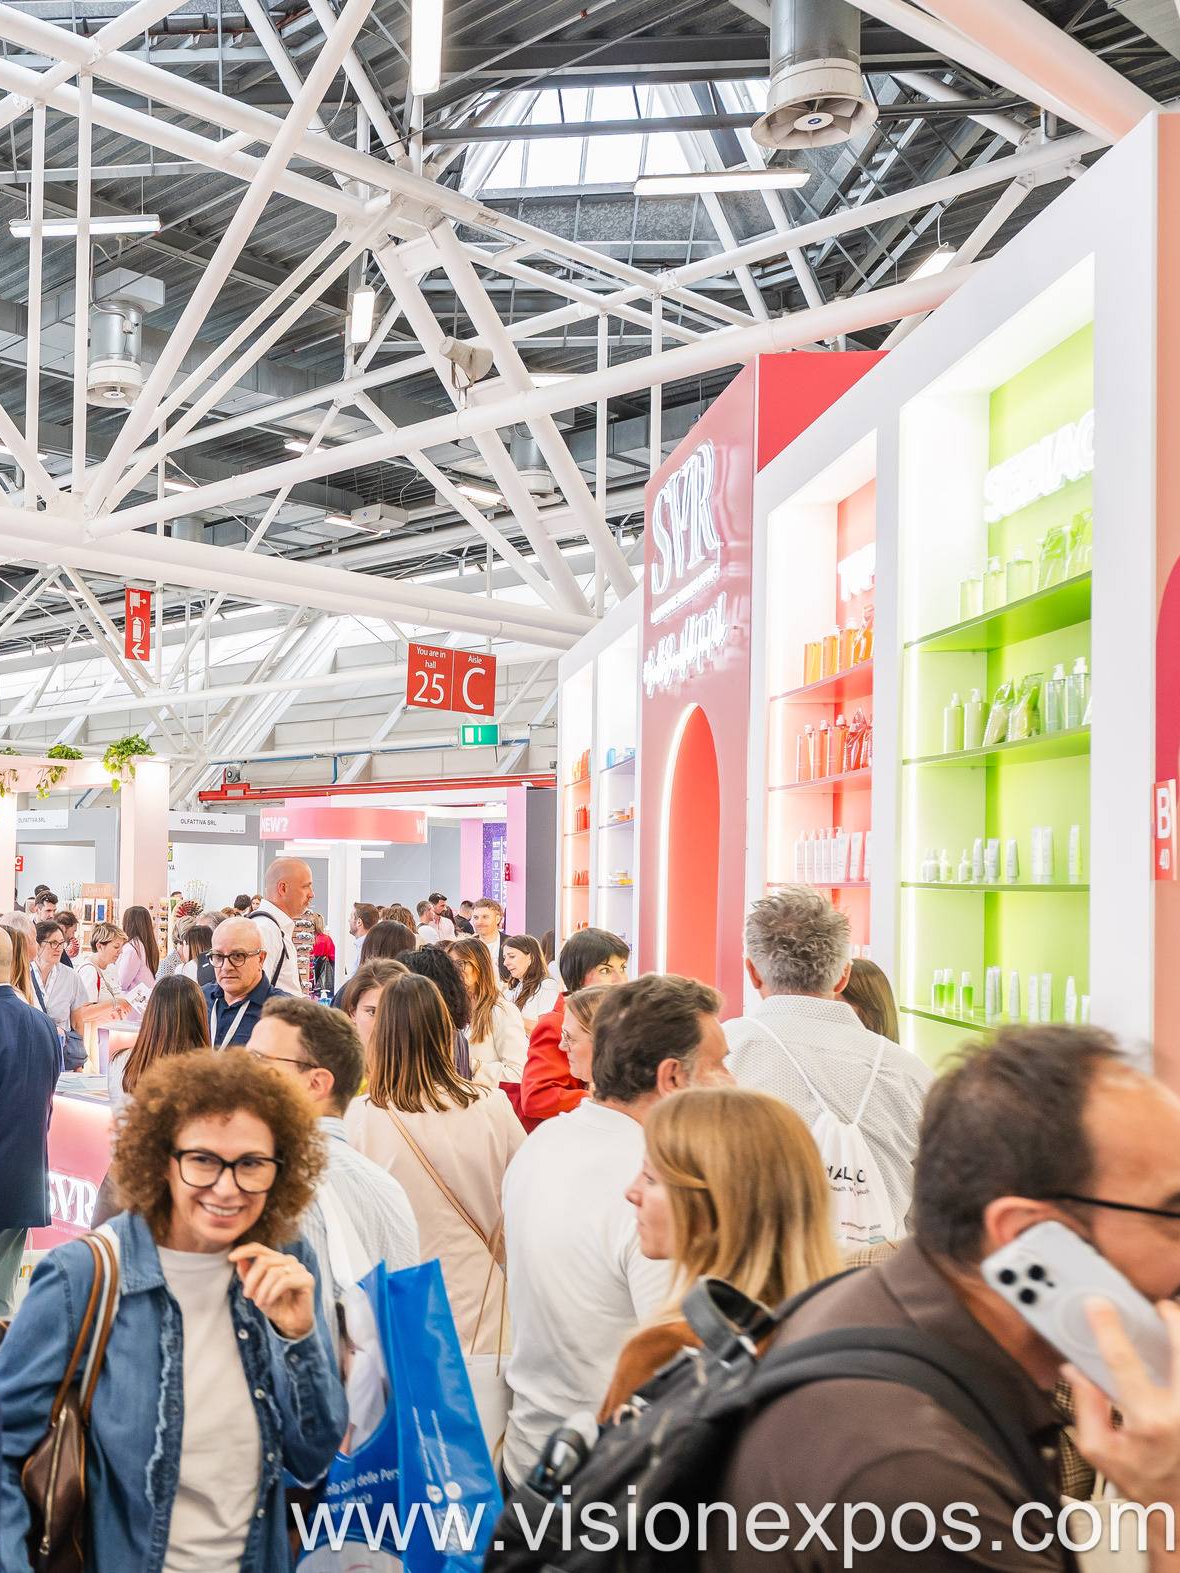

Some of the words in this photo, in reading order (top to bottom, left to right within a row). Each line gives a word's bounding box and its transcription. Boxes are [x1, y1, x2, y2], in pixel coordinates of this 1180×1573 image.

[652, 439, 723, 595] SVR
[416, 646, 429, 656] You
[429, 650, 439, 658] are
[440, 650, 446, 659] in
[424, 659, 437, 669] hall
[467, 654, 483, 665] Aisle
[413, 670, 445, 705] 25
[462, 667, 486, 711] C
[1156, 787, 1171, 839] B
